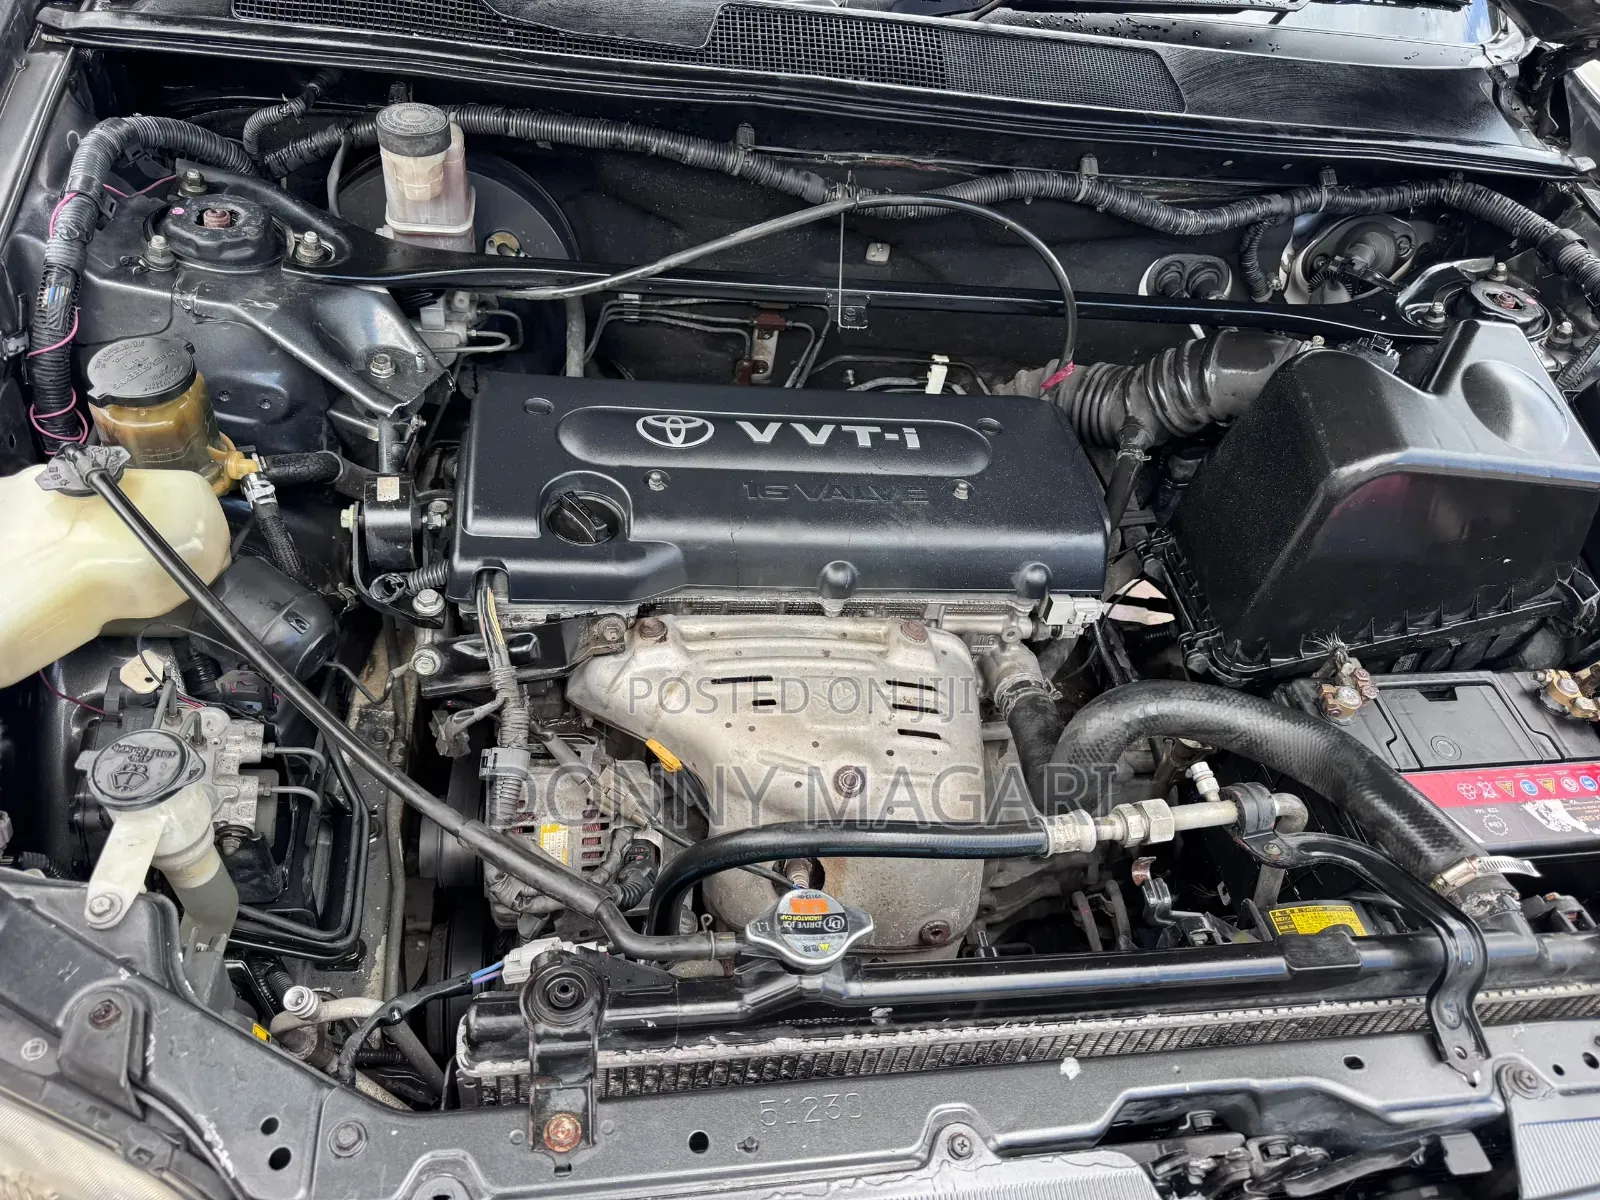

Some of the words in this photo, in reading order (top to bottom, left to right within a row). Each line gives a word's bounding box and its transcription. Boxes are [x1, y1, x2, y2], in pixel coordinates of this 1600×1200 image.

[735, 420, 921, 450] VVT-i
[794, 483, 930, 505] VALVE
[797, 920, 823, 929] DRIVE
